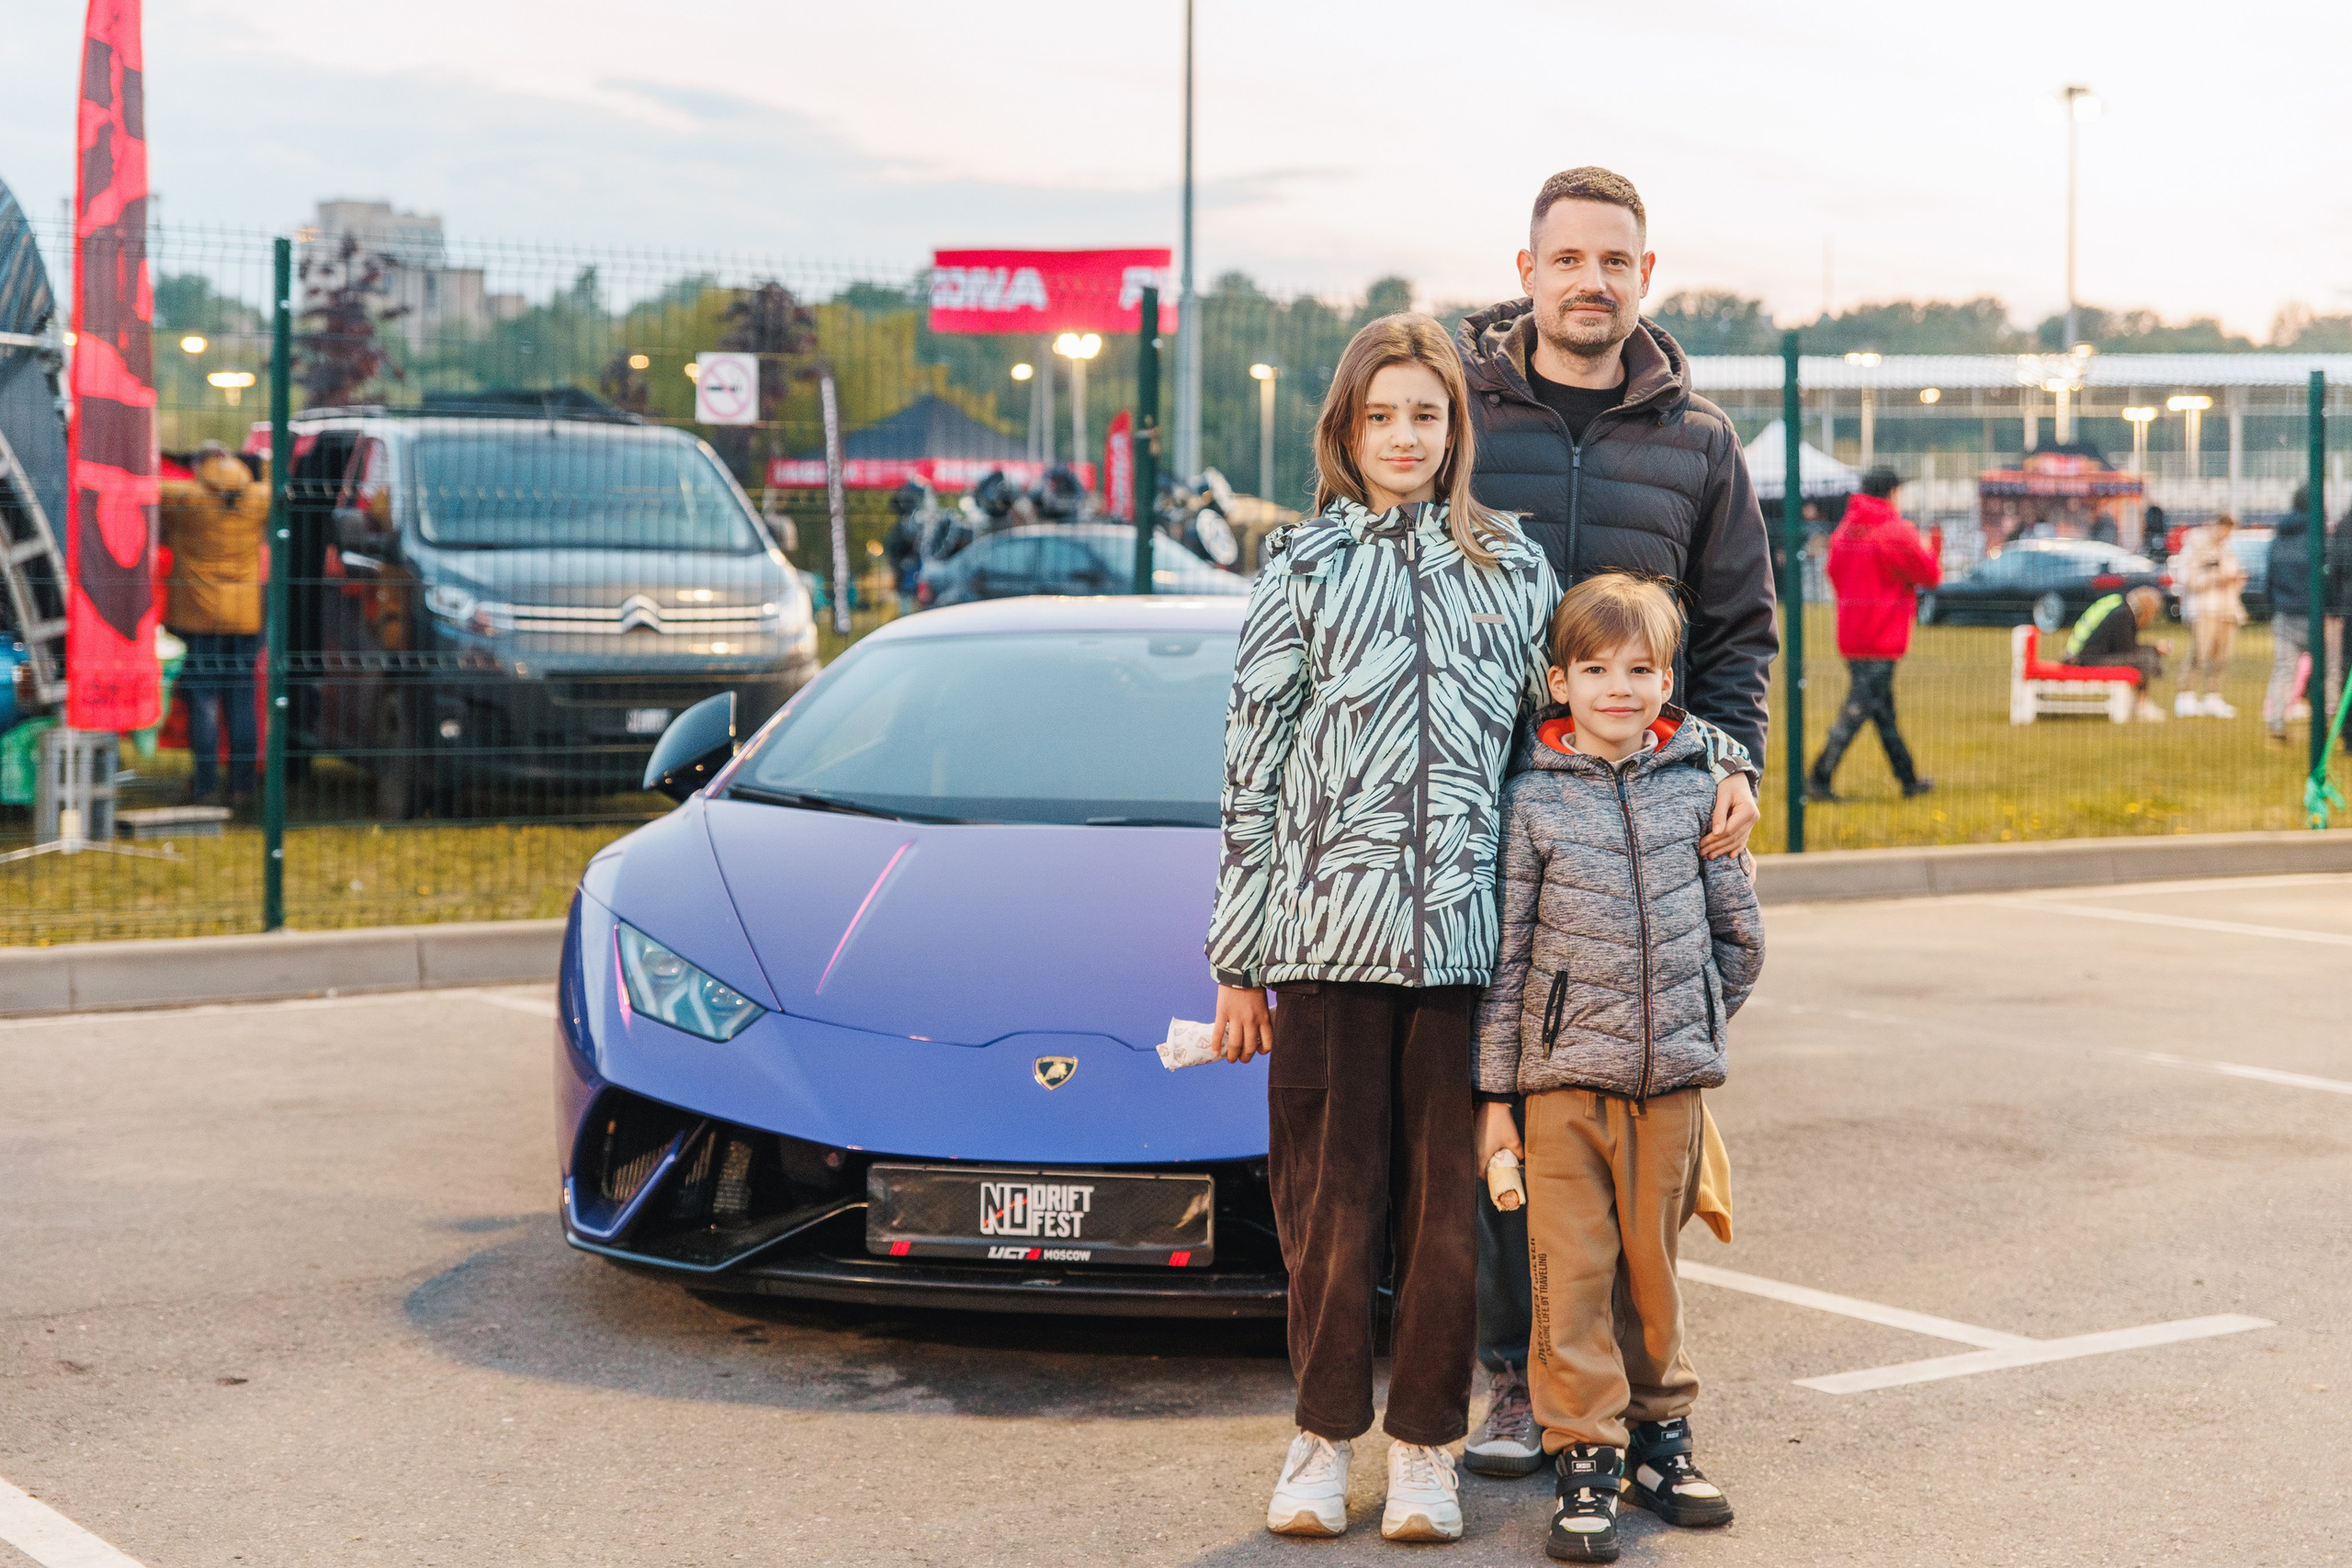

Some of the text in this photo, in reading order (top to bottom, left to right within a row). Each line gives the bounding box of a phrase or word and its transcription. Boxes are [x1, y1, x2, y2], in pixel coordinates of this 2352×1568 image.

[1033, 1183, 1094, 1213] DRIFT
[1033, 1212, 1084, 1237] FEST
[1043, 1248, 1091, 1262] MOSCOW
[1540, 1295, 1549, 1306] BY
[1541, 1306, 1550, 1324] LIFE
